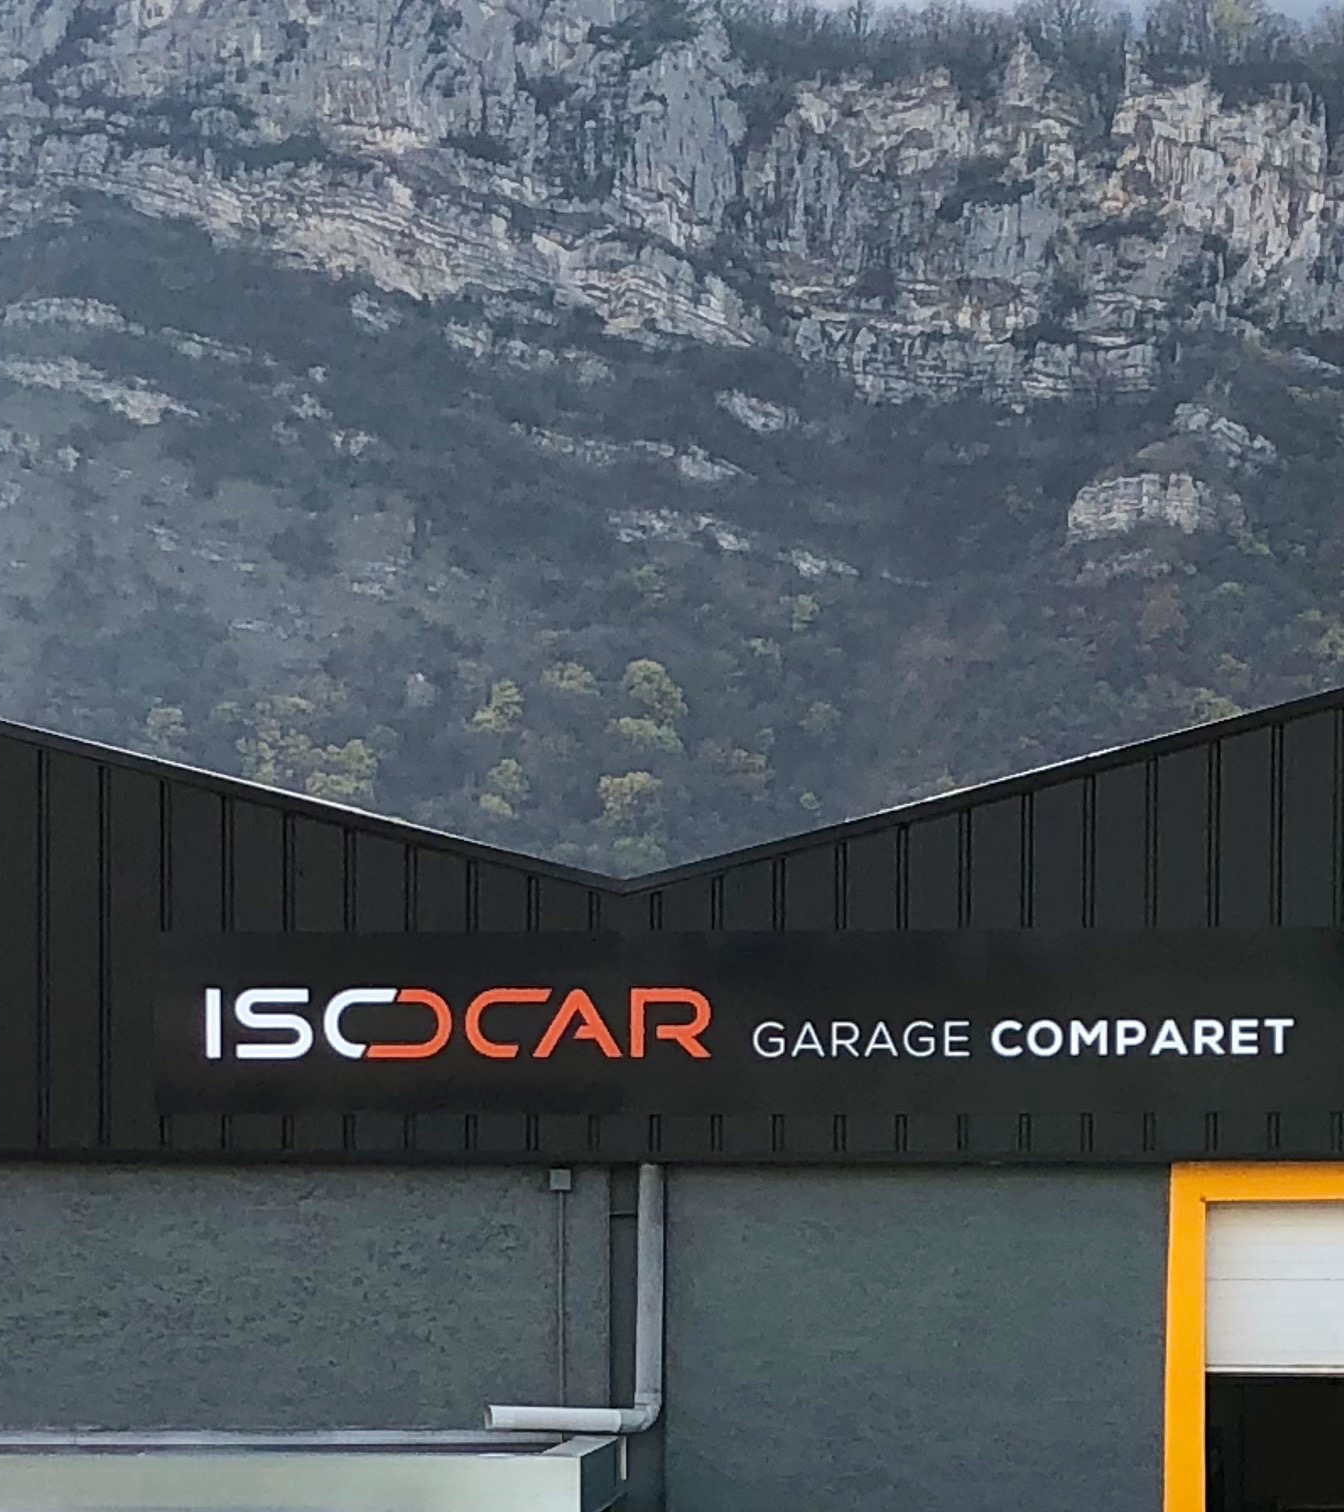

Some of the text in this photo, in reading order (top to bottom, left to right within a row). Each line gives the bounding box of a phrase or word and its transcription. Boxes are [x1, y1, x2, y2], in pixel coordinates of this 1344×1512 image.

[204, 986, 712, 1060] ISOCAR
[752, 1017, 1295, 1058] GARAGE COMPARET
